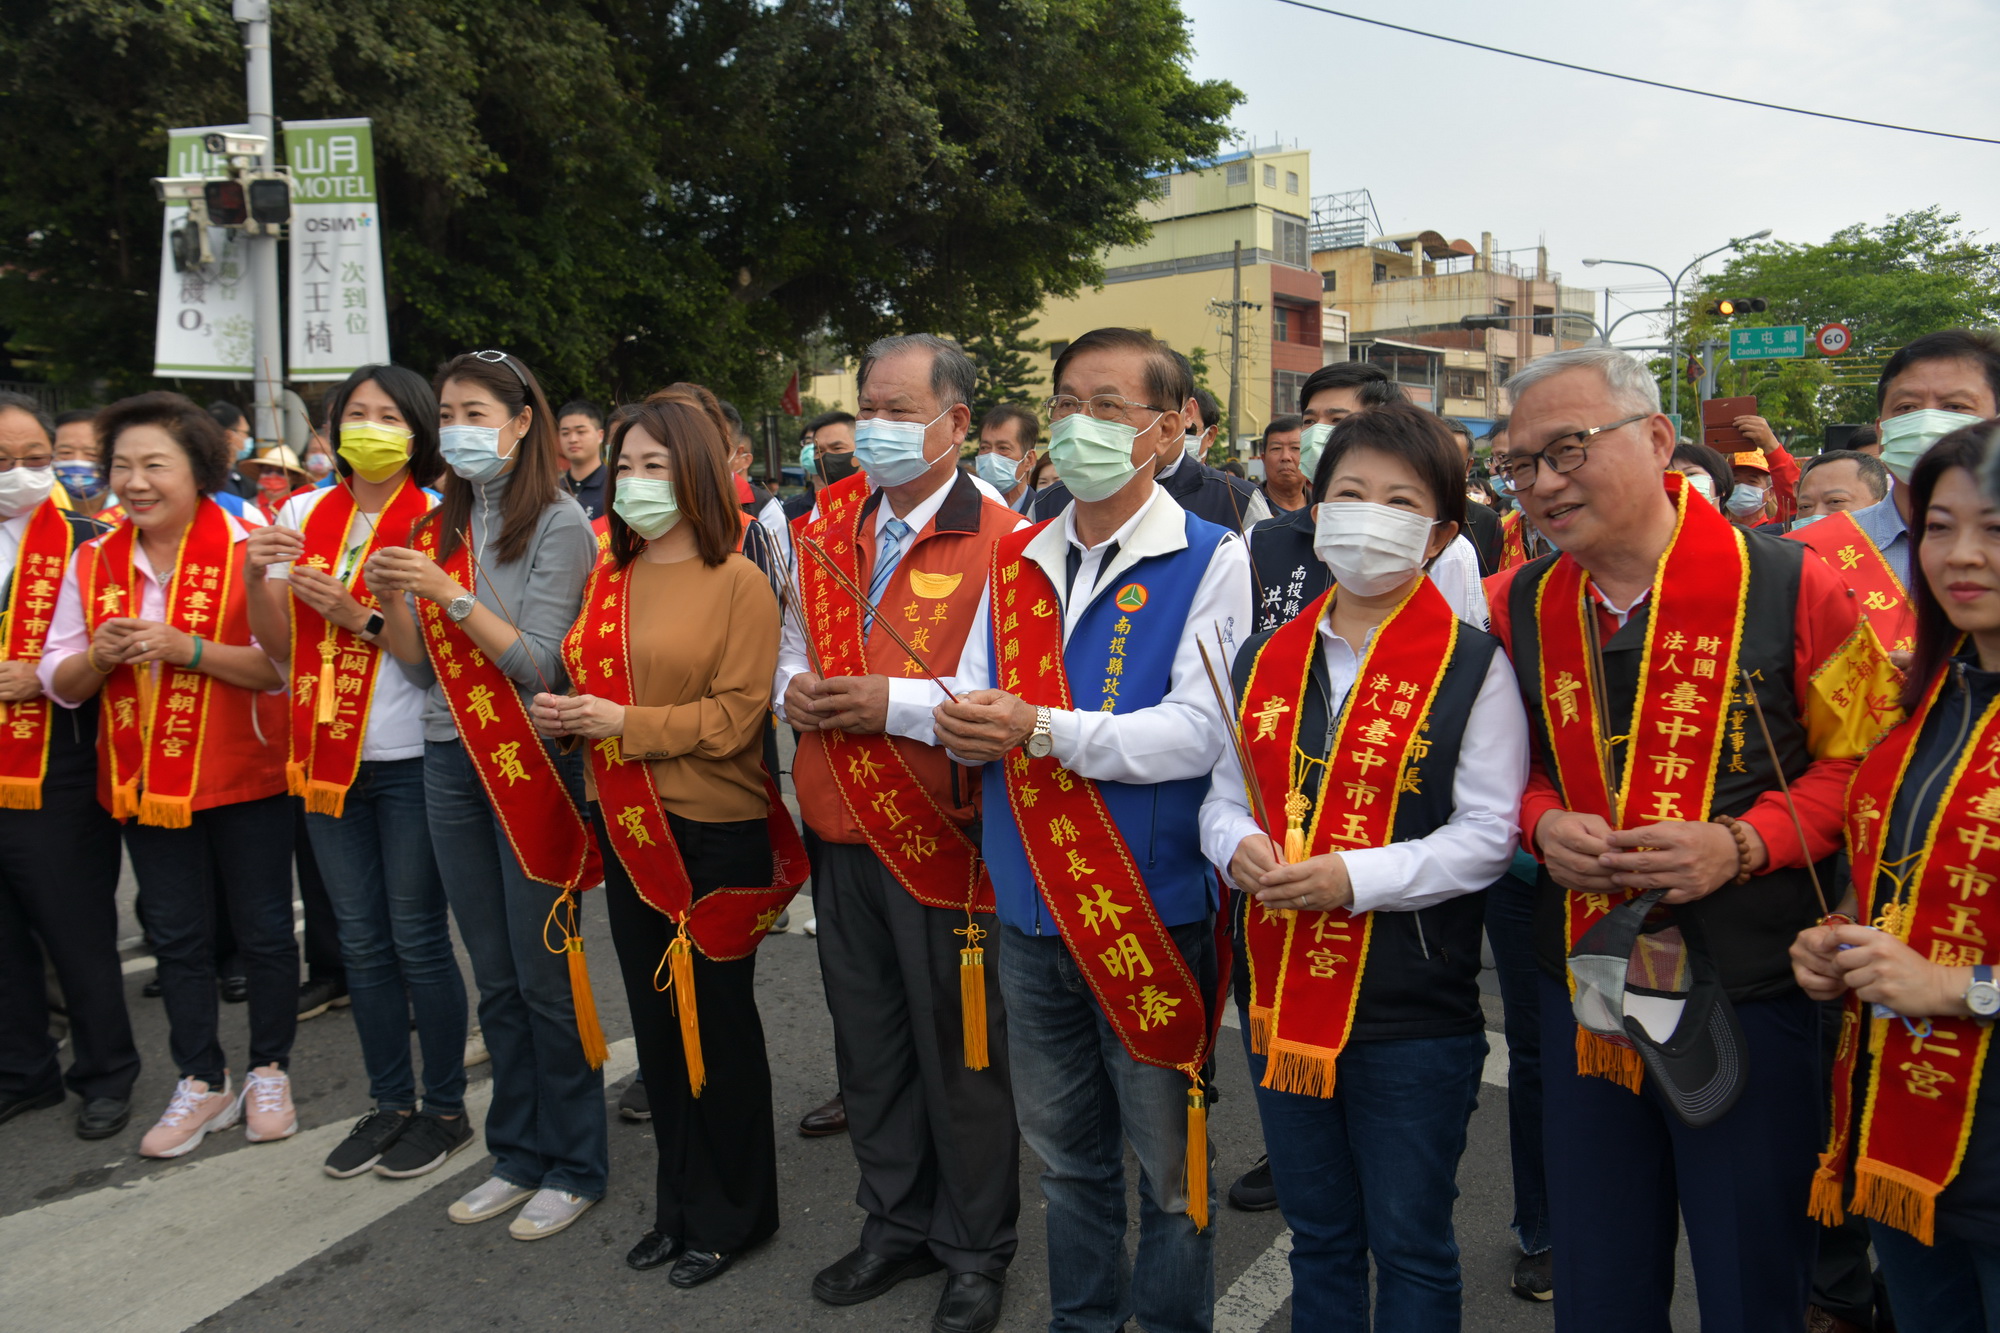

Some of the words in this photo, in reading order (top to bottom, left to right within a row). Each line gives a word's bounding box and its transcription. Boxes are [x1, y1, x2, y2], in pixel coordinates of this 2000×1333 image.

[294, 136, 358, 175] 山月
[293, 176, 372, 198] MOTEL
[305, 217, 356, 232] OSIM
[302, 241, 333, 354] 天王椅
[339, 242, 369, 335] 一次到位
[1736, 329, 1798, 345] 草屯鎮
[1736, 346, 1761, 356] Caotun
[1764, 345, 1798, 356] Township
[1823, 333, 1844, 346] 60
[1281, 564, 1307, 625] 南投縣
[9, 579, 57, 739] 臺中市玉仁宮
[1099, 615, 1132, 713] 南投縣政府
[1658, 630, 1688, 675] 法人
[1001, 559, 1041, 808] 開台祖廟五神爺
[1361, 673, 1392, 712] 法人
[1549, 670, 1583, 728] 貴
[465, 683, 531, 788] 貴賓
[1251, 694, 1291, 744] 貴
[1048, 813, 1096, 882] 縣長
[1305, 717, 1398, 980] 臺中市玉仁宮
[1898, 786, 2000, 1100] 臺中市玉闕仁宮
